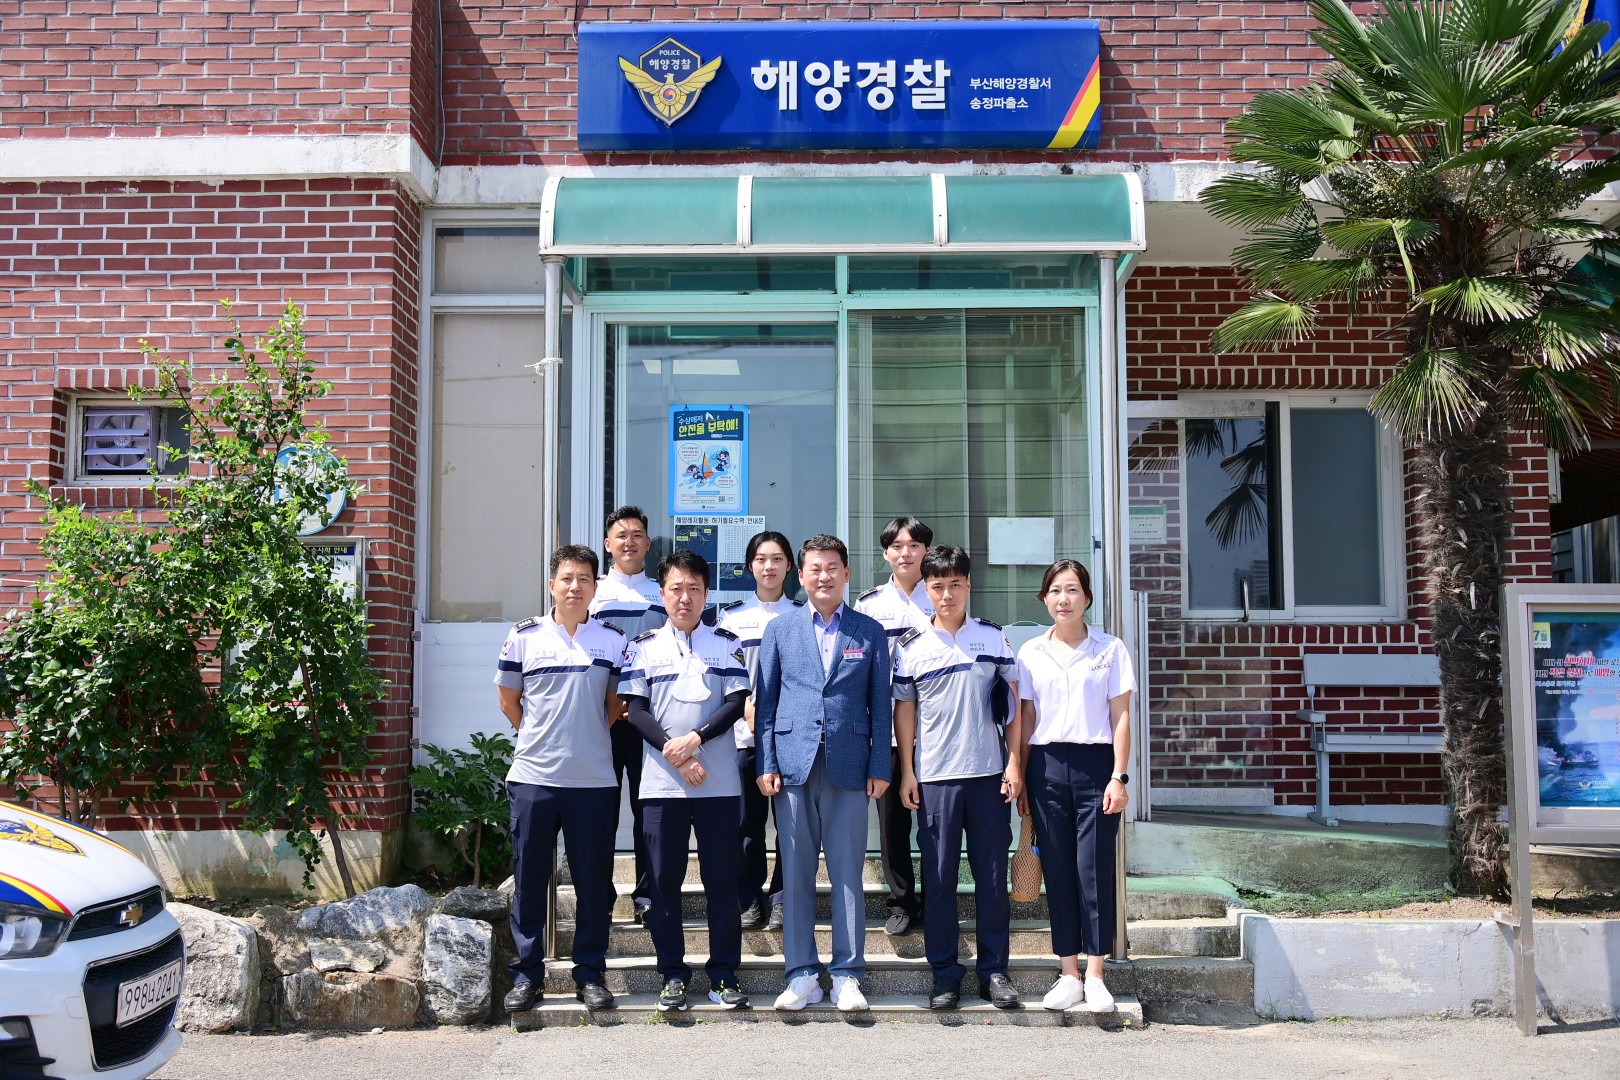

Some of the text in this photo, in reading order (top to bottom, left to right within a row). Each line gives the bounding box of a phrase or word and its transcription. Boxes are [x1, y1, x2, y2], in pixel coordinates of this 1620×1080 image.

[649, 59, 691, 70] 해양경찰
[750, 59, 951, 111] 해양경찰
[969, 77, 1051, 90] 부산해양경찰서
[969, 97, 1029, 110] 송정파출소
[678, 418, 739, 438] 안전을 부탁해!
[125, 967, 177, 1016] 998너2241
